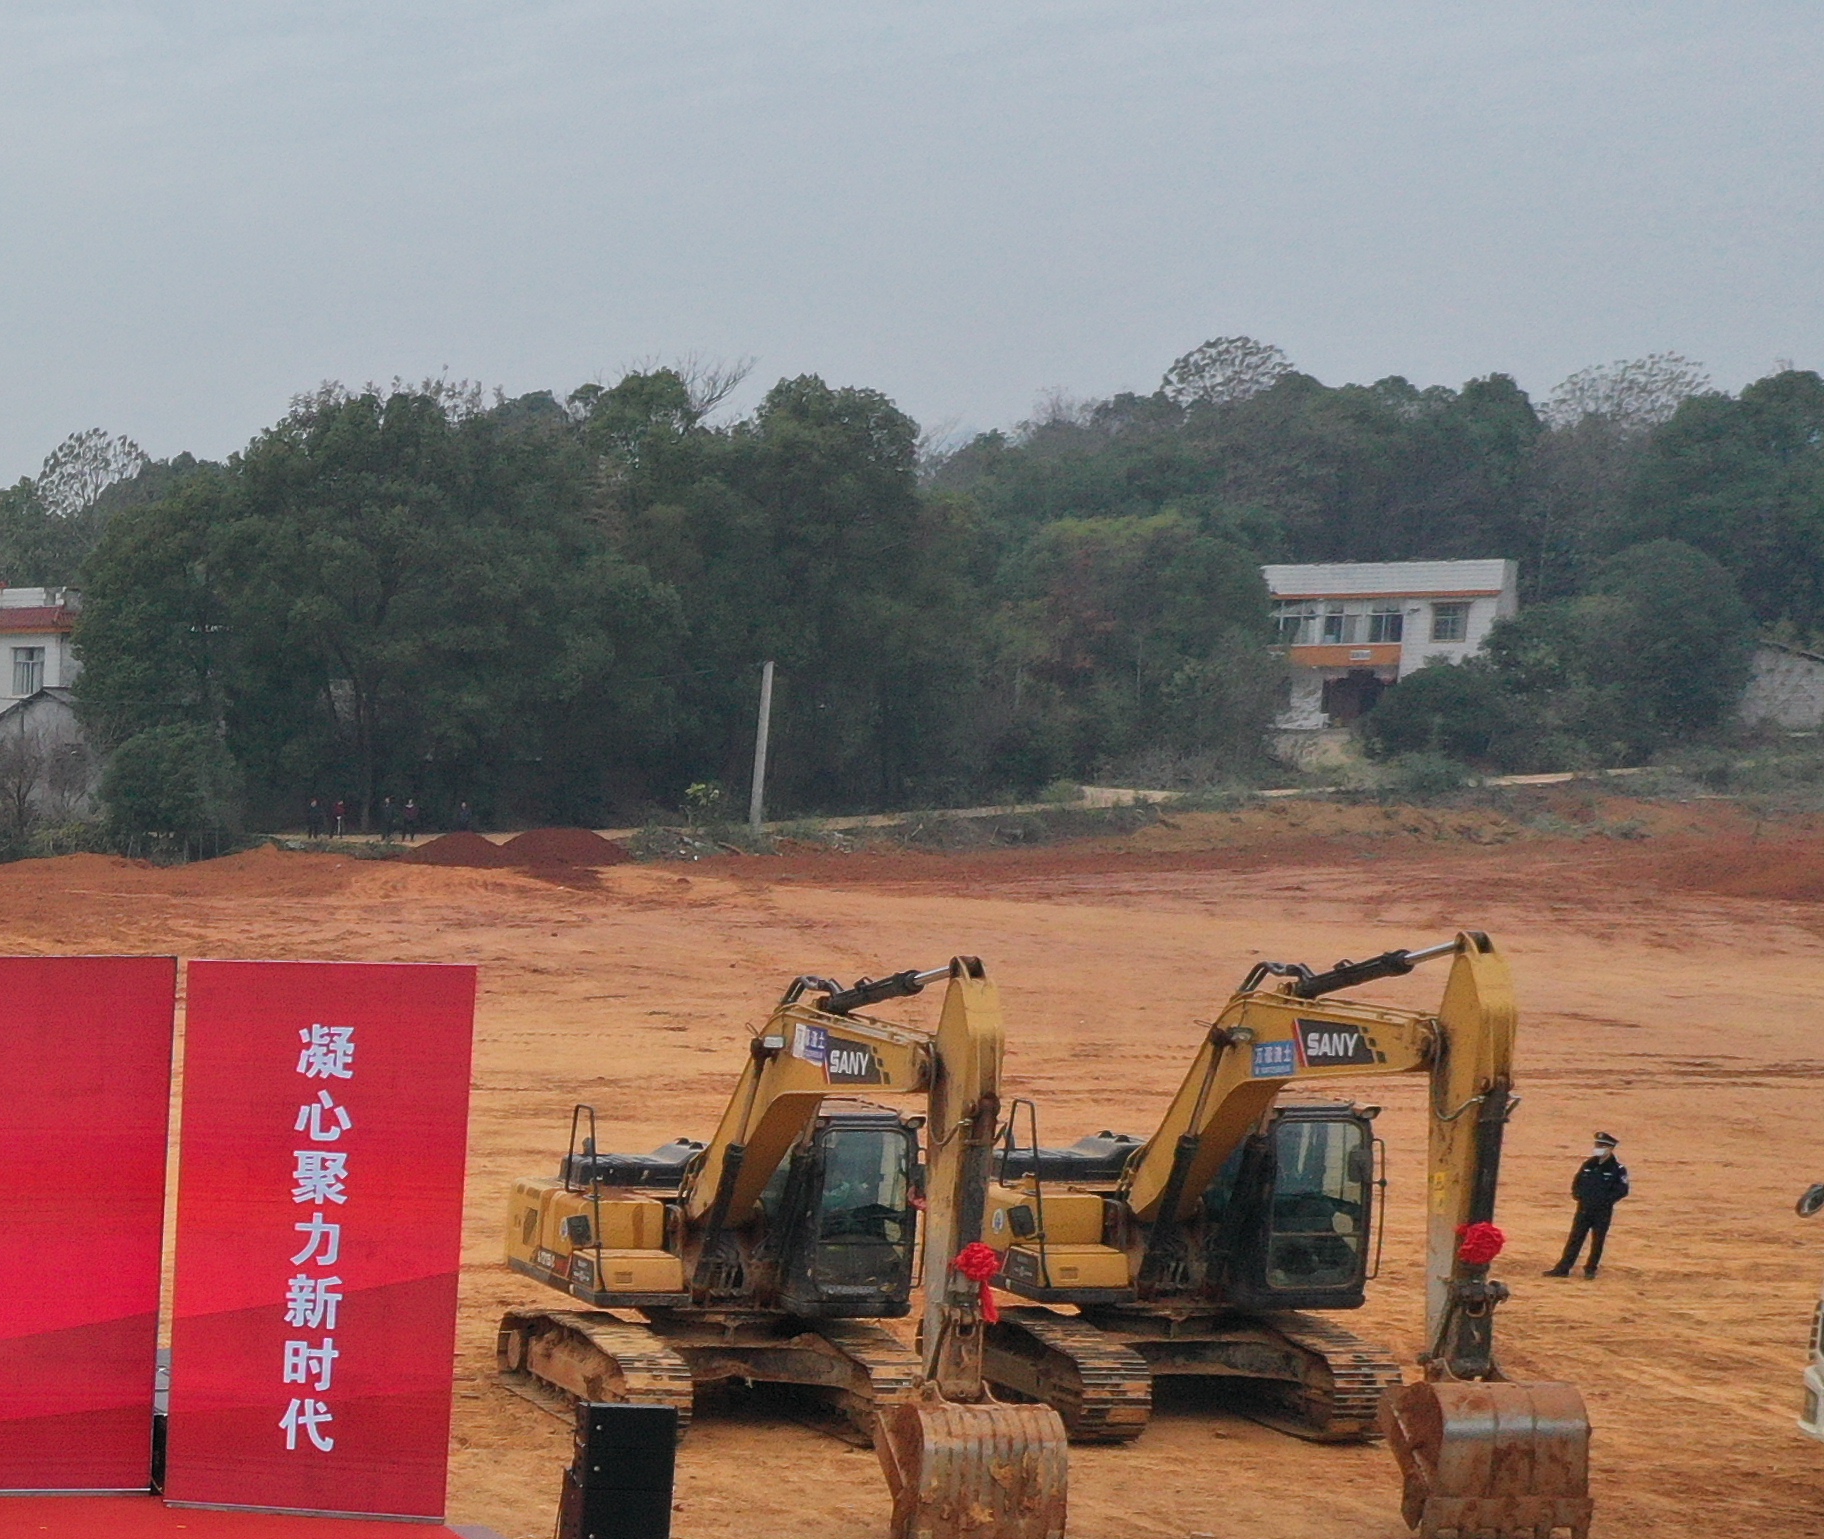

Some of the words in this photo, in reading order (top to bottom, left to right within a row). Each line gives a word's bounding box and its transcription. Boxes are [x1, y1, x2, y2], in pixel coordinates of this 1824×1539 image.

[1307, 1032, 1358, 1056] SANY
[830, 1050, 869, 1075] SANY
[278, 1023, 355, 1452] 凝心聚力新时代
